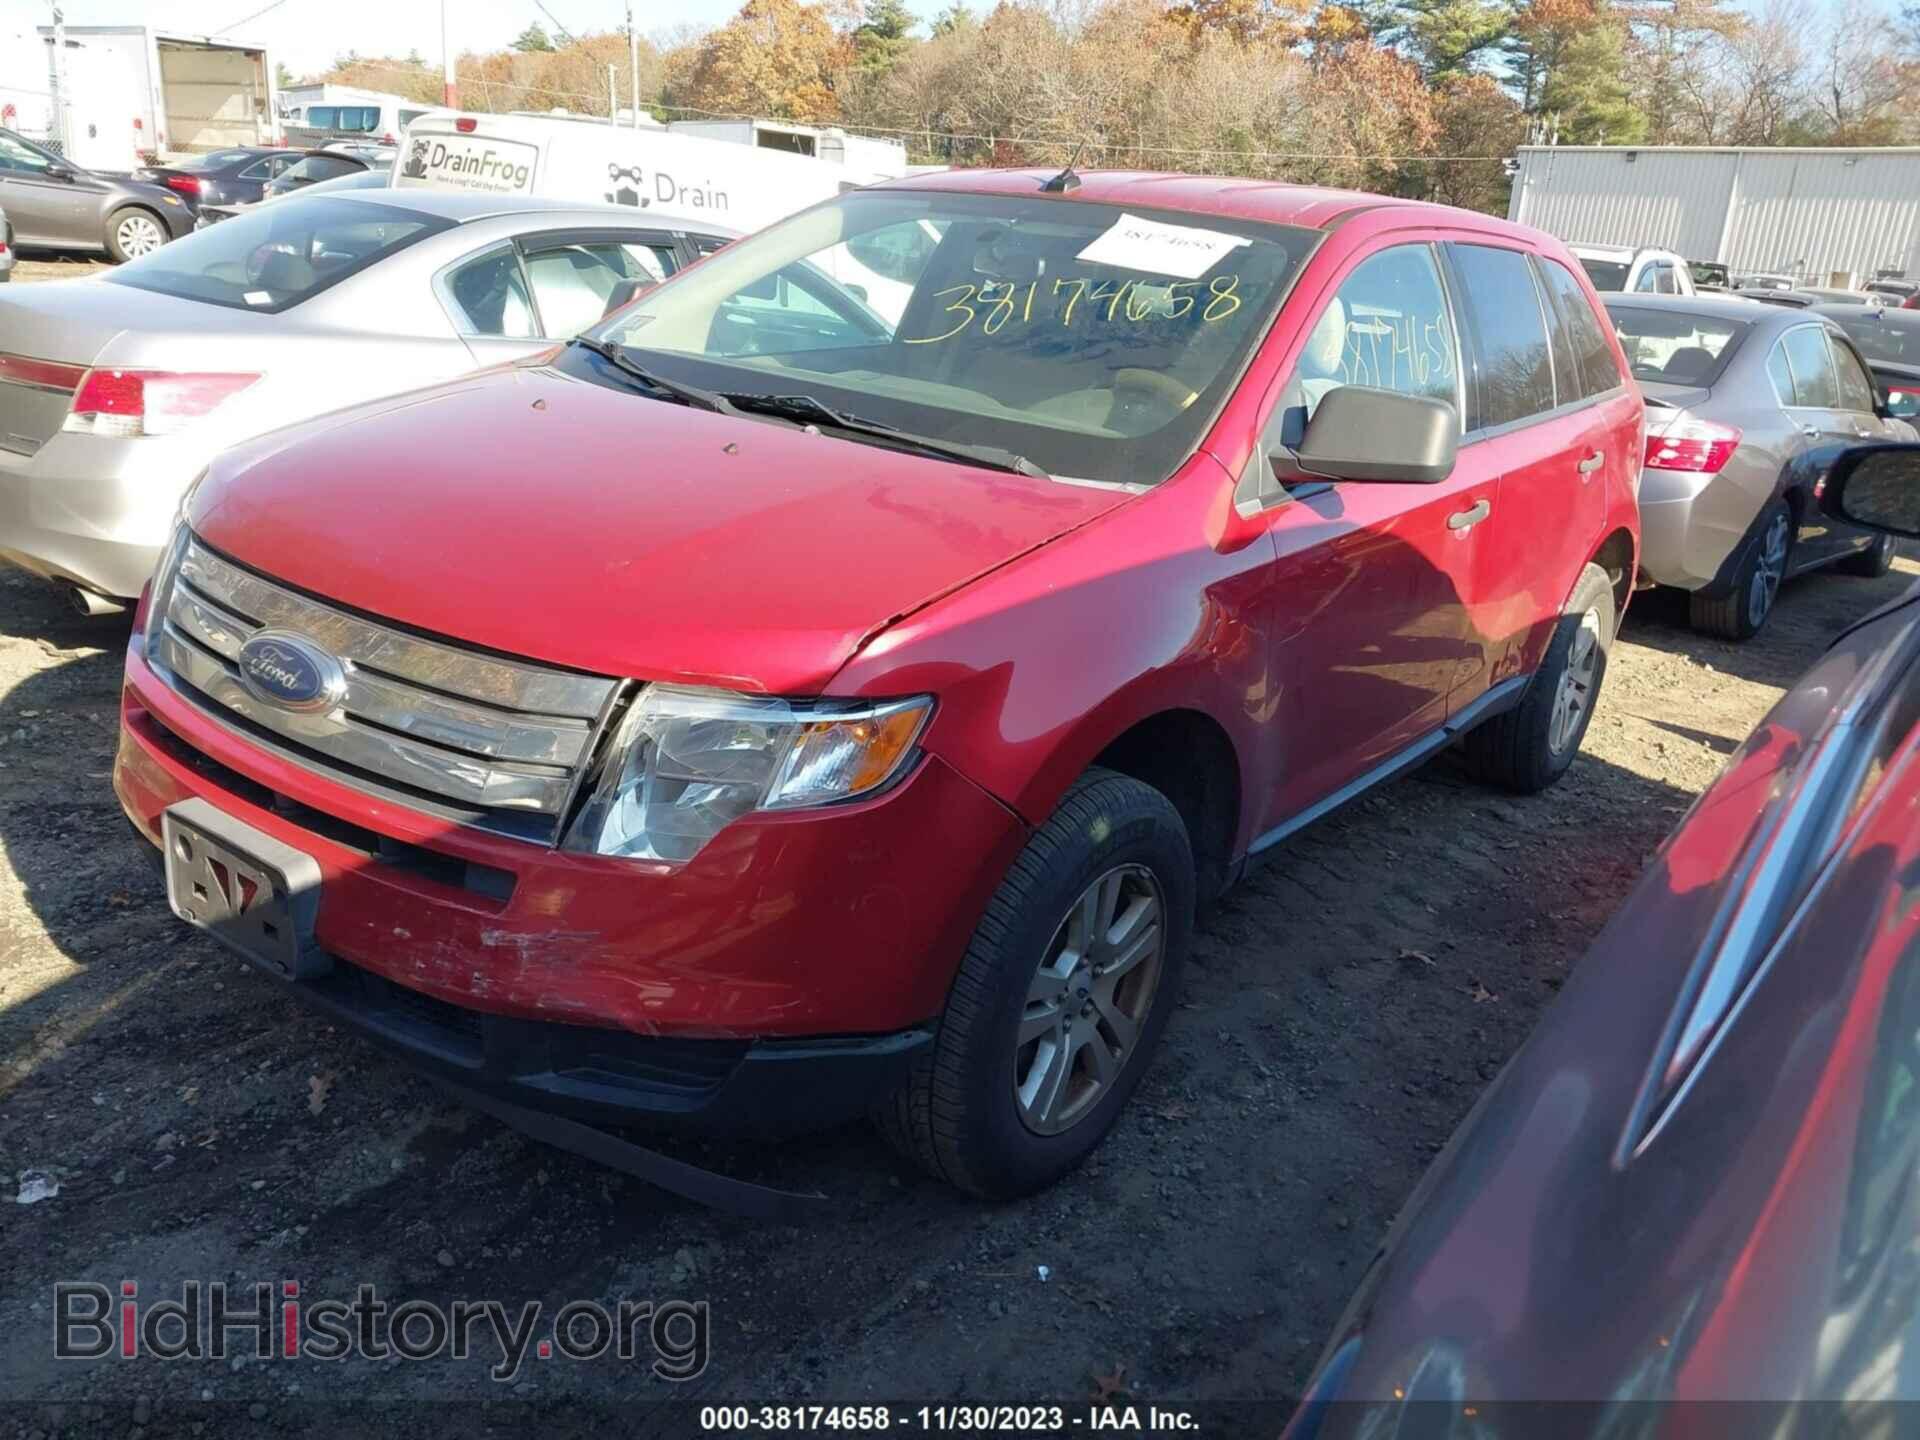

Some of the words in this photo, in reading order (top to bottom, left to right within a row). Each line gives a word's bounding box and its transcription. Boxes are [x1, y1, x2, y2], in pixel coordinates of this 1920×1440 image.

[430, 143, 529, 189] DrainFrog
[655, 172, 729, 211] Drain
[903, 274, 1241, 344] 38174658
[250, 645, 303, 690] Ford
